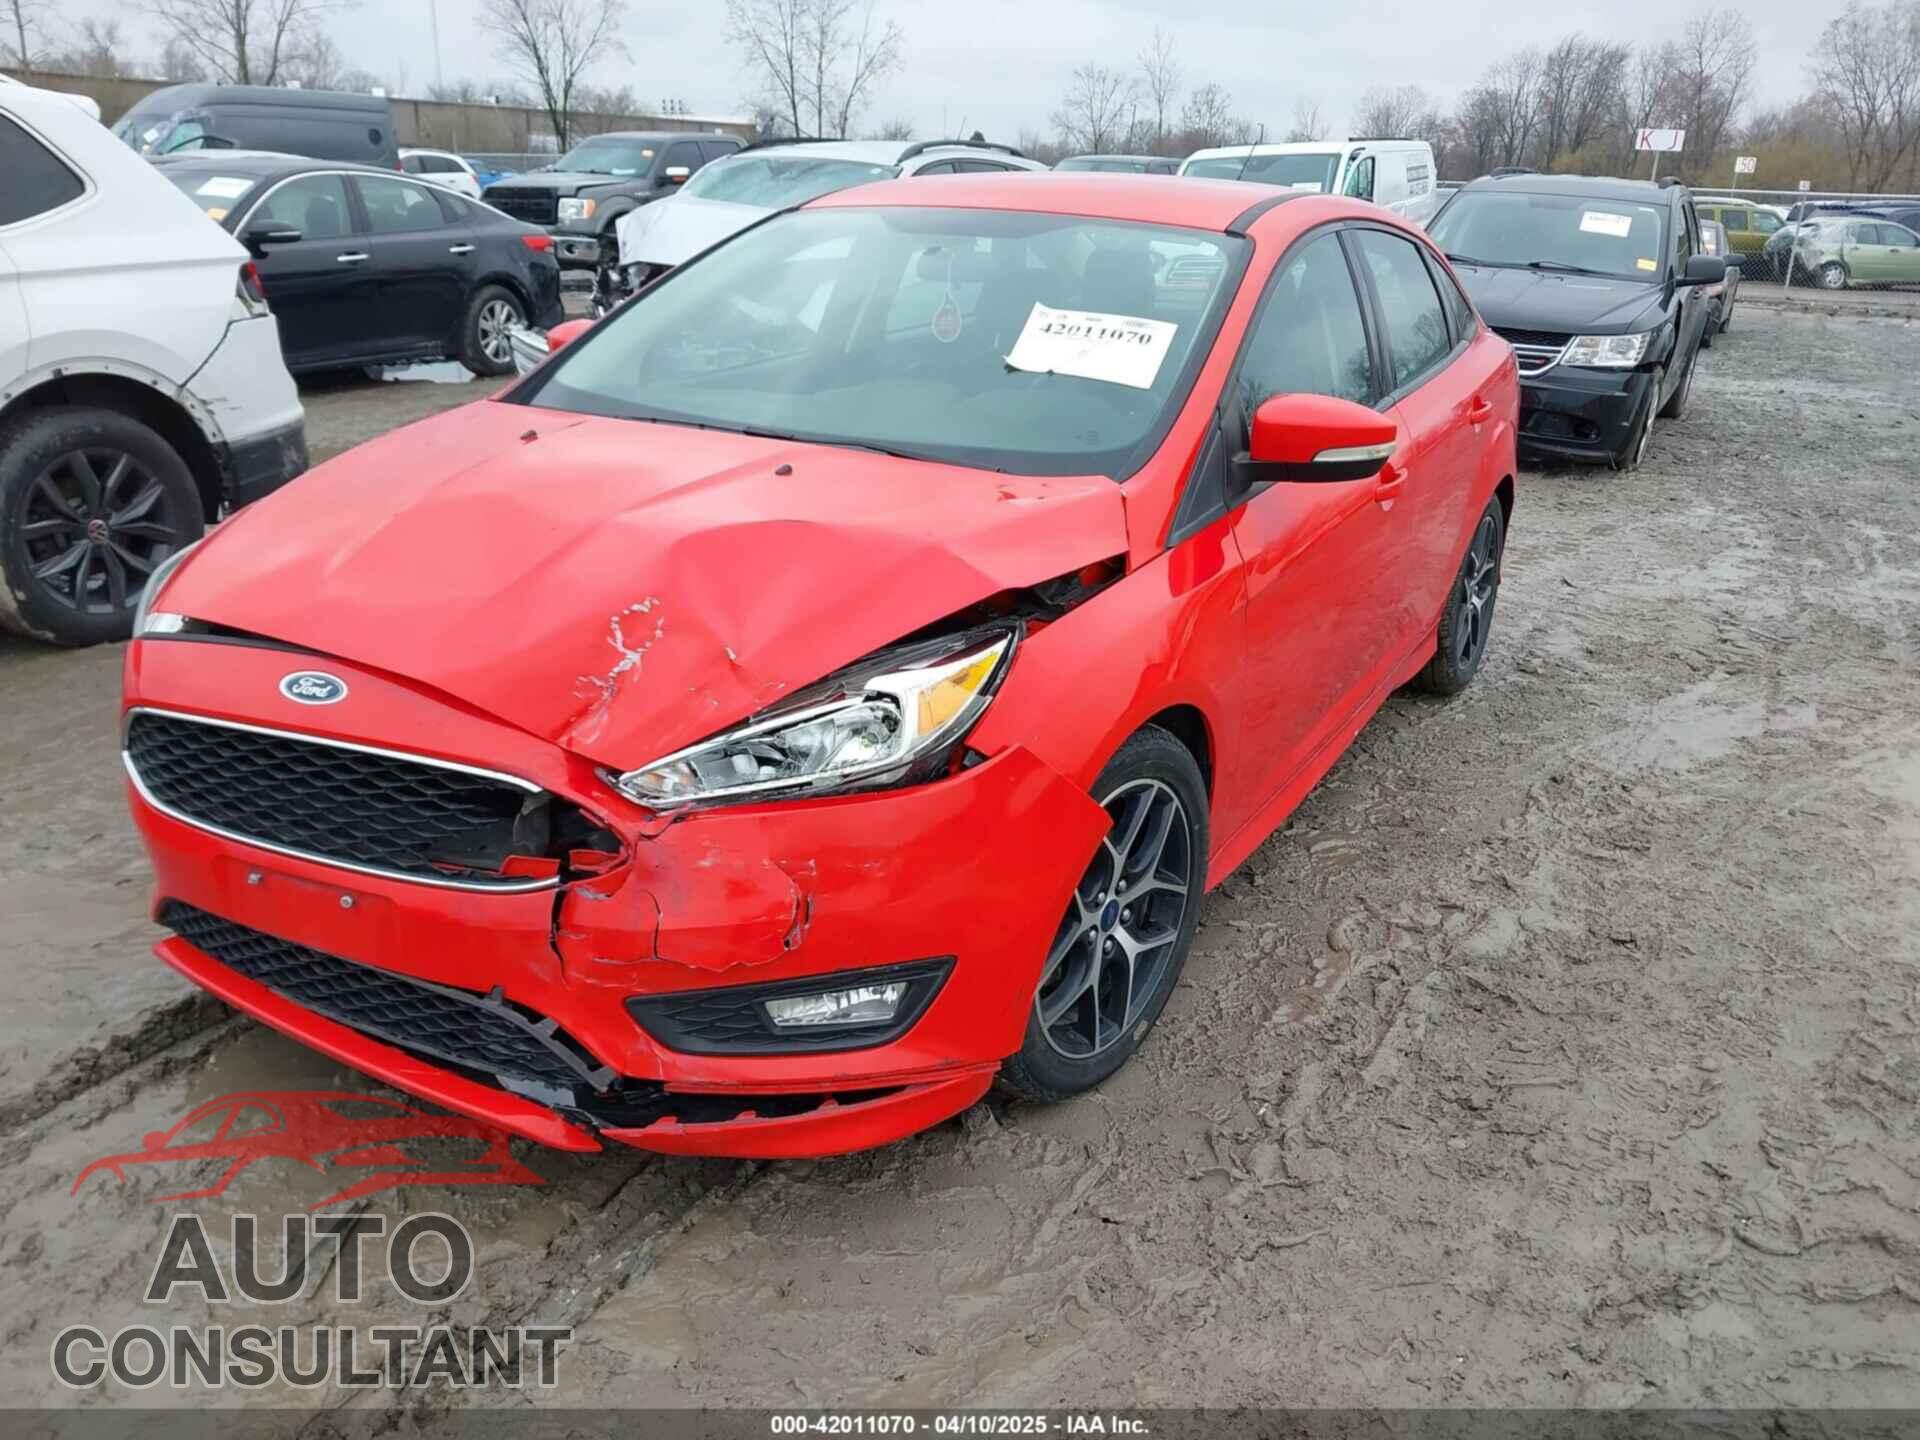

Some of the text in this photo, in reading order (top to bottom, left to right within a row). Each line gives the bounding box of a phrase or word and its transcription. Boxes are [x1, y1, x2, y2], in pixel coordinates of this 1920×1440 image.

[1640, 129, 1679, 150] K J
[1040, 322, 1153, 345] 42011070
[292, 677, 333, 698] Ford
